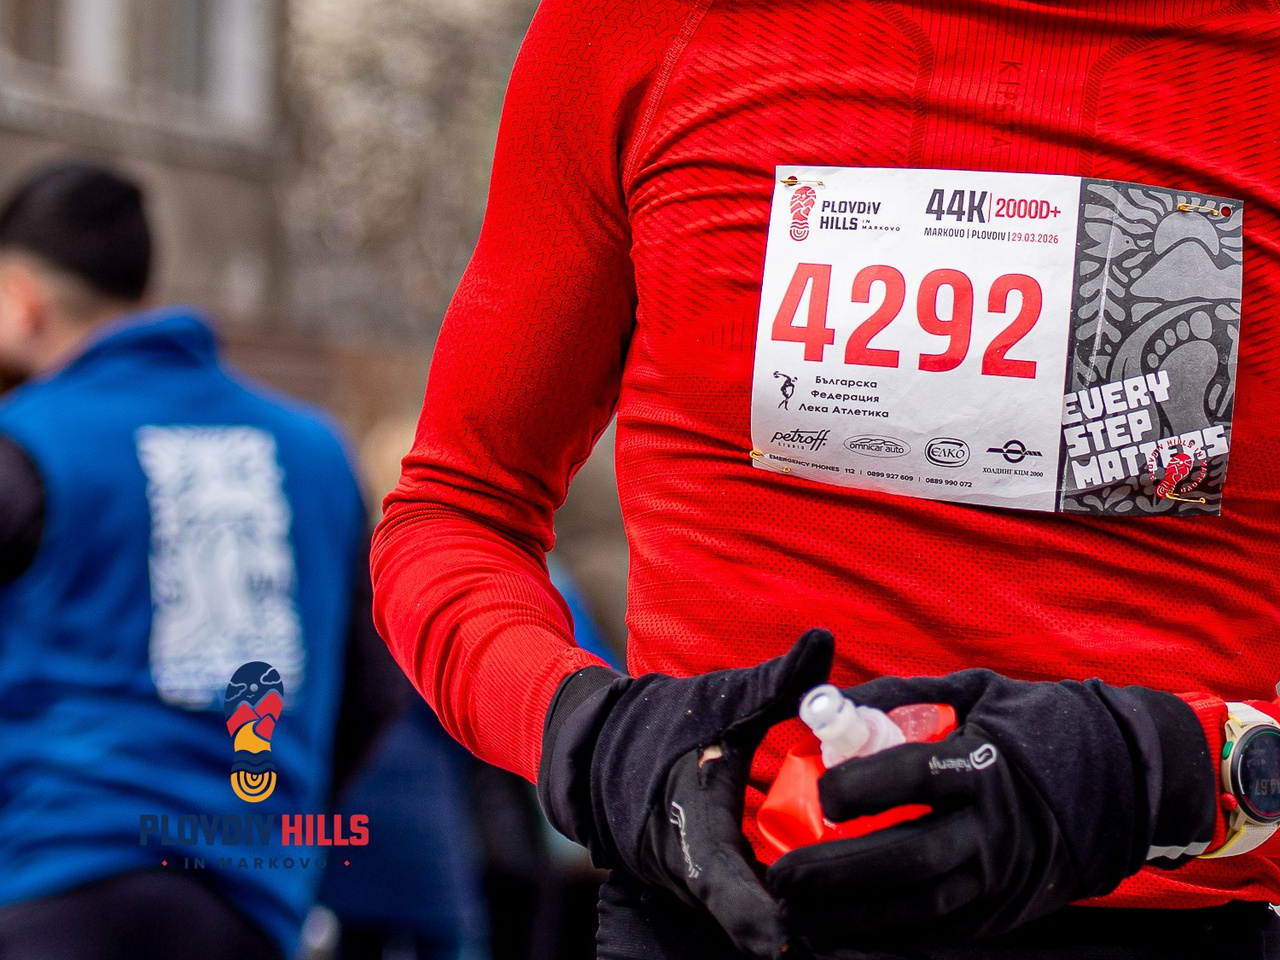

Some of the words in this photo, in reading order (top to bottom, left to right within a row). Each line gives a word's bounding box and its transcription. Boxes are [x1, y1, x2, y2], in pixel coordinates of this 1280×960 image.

[821, 200, 881, 215] PLOVDIV
[925, 188, 988, 223] 44K
[995, 198, 1061, 220] 2000D+
[820, 216, 858, 230] HILLS
[924, 227, 965, 238] MARKOVO
[971, 230, 1006, 241] PLOVDIV
[1011, 232, 1059, 244] 29.03.2026
[771, 262, 1043, 379] 4292
[815, 375, 878, 388] Българска
[811, 390, 880, 403] Федерация
[1062, 370, 1171, 425] EVERY
[798, 403, 829, 413] Лека
[832, 405, 889, 418] Атлетика
[1063, 409, 1153, 458] STEP
[849, 442, 883, 452] omnicar
[885, 445, 905, 454] auto
[769, 453, 811, 467] EMERGENCY
[811, 463, 840, 472] PHONES
[866, 470, 885, 478] 0899
[1071, 425, 1229, 490] MATTERS
[982, 467, 1013, 475] ХОЛДИНГ
